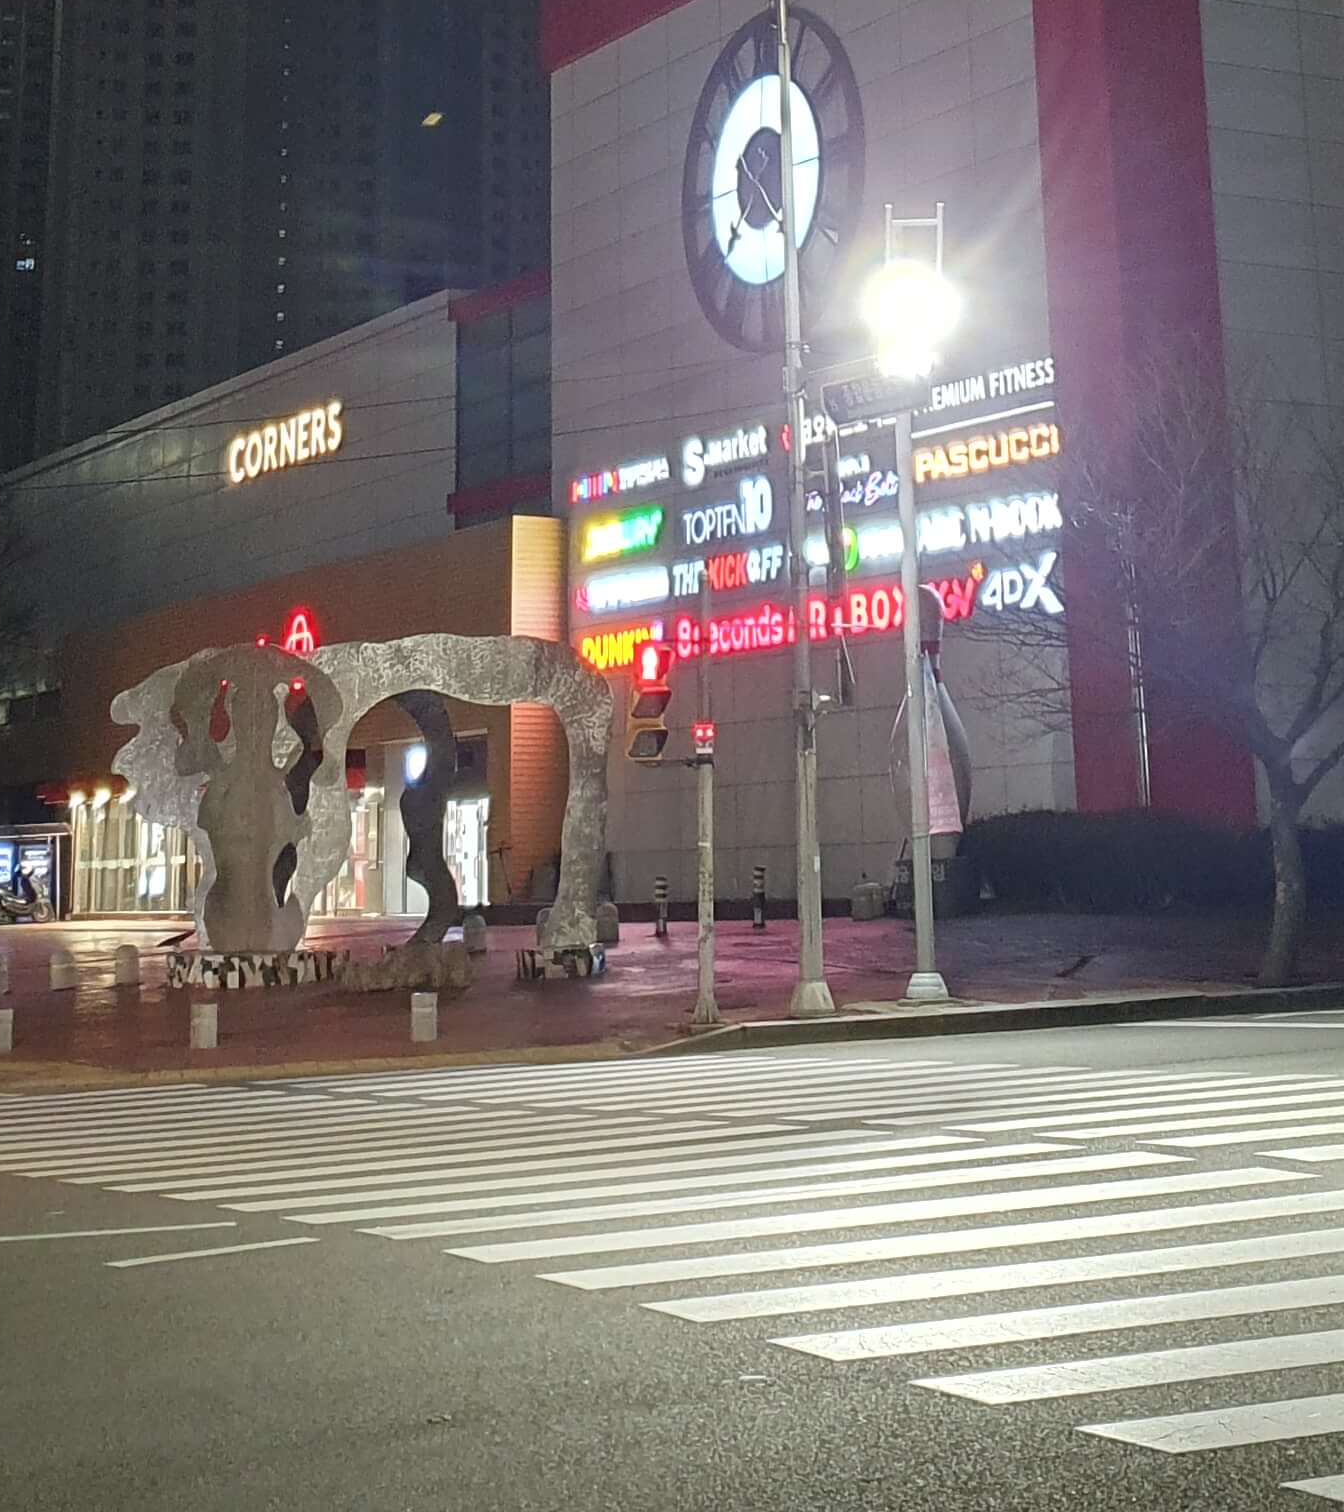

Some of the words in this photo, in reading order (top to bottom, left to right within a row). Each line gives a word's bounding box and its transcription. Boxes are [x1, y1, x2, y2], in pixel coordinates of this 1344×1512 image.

[988, 357, 1055, 398] FITNESS
[229, 401, 343, 484] CORNERS
[914, 422, 1061, 484] PASCUCCI
[982, 551, 1065, 614] 4DX
